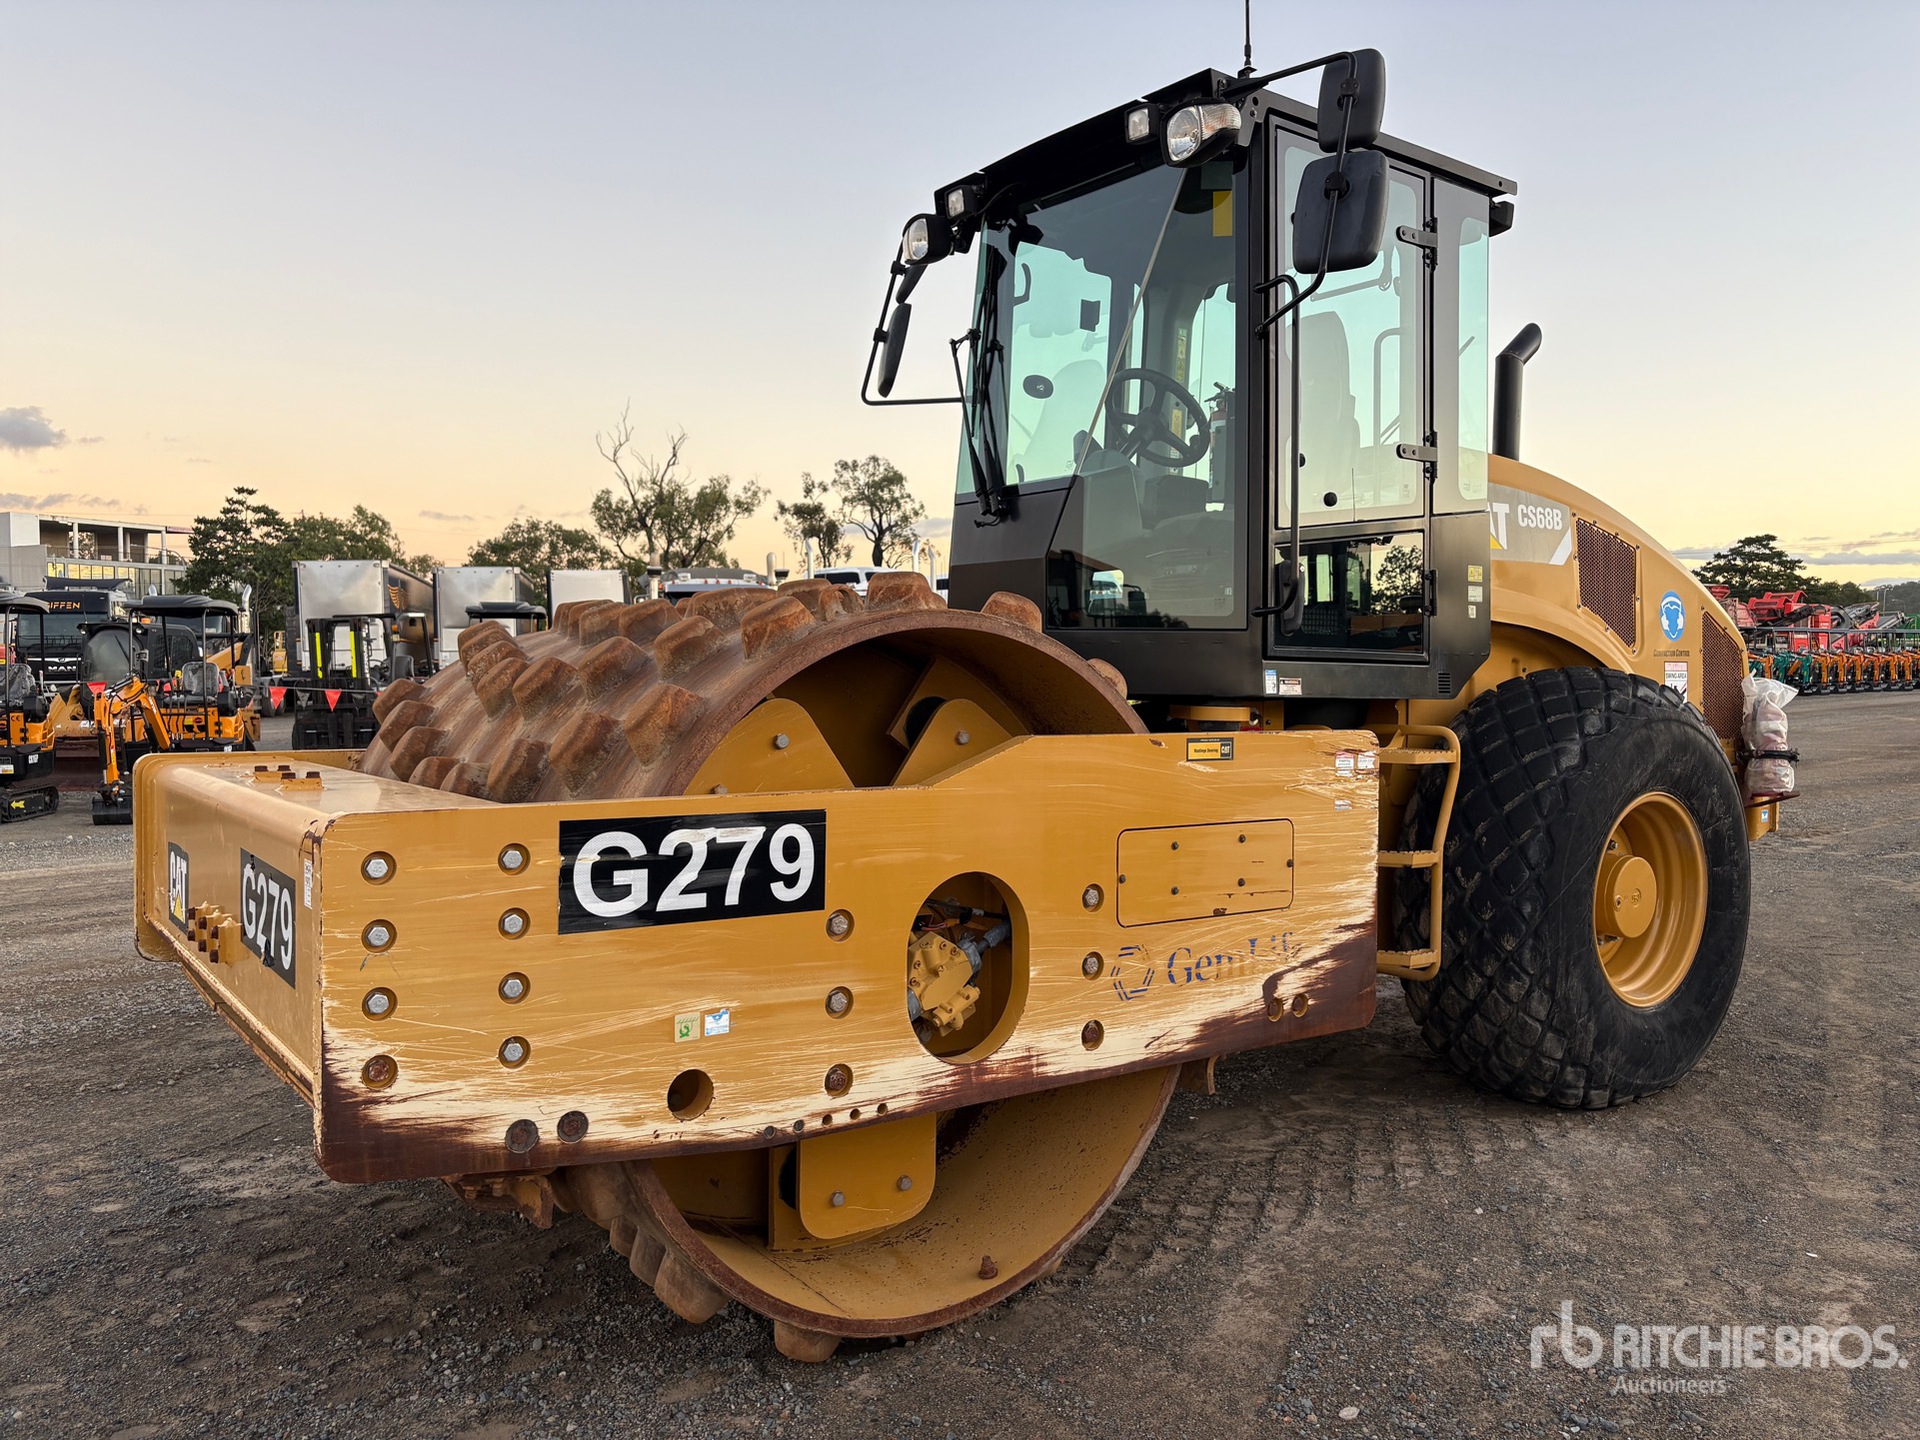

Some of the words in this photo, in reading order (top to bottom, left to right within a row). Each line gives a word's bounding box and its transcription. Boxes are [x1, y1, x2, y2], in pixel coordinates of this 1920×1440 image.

[1517, 504, 1563, 531] CS68B
[169, 850, 188, 924] CAT
[573, 822, 815, 918] G279
[242, 863, 293, 970] G279
